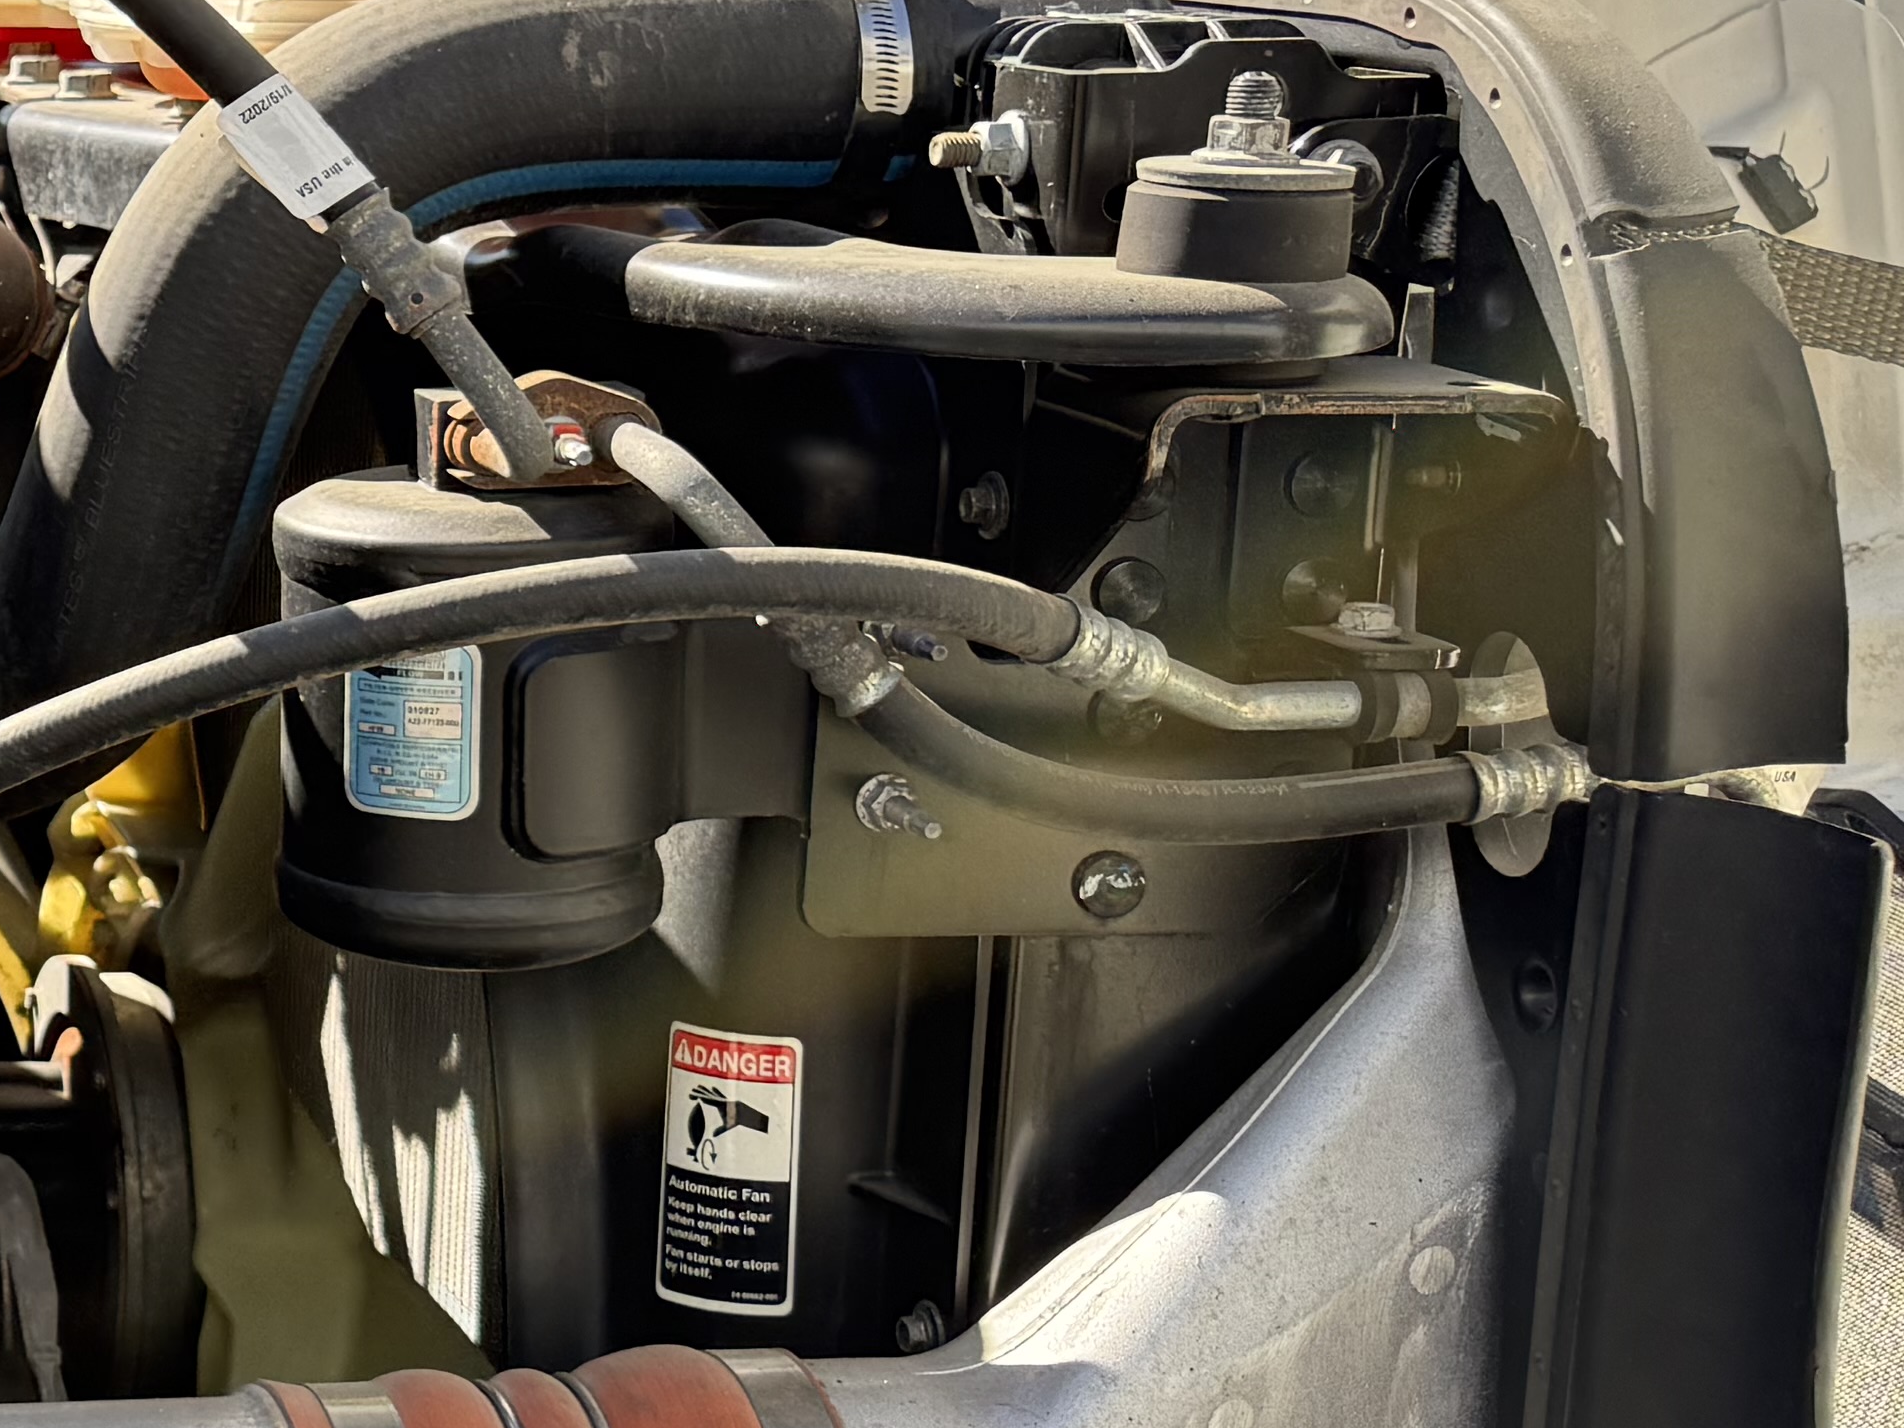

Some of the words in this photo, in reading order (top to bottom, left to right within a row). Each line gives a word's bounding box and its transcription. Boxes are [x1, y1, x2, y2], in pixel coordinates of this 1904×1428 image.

[323, 161, 344, 180] the
[295, 176, 323, 198] USA
[693, 1045, 792, 1078] DANGER
[668, 1174, 738, 1201] Automatic
[742, 1188, 771, 1203] Fan
[667, 1196, 695, 1215] Keep
[697, 1204, 736, 1221] hands
[738, 1210, 773, 1223] clear
[666, 1227, 712, 1247] running.
[667, 1211, 695, 1228] when
[697, 1220, 740, 1238] engine
[743, 1223, 756, 1237] is
[664, 1259, 678, 1278] by
[679, 1261, 713, 1280] itself.
[665, 1244, 684, 1260] Fan
[686, 1249, 723, 1267] starts
[725, 1257, 741, 1269] or
[742, 1257, 780, 1273] stops
